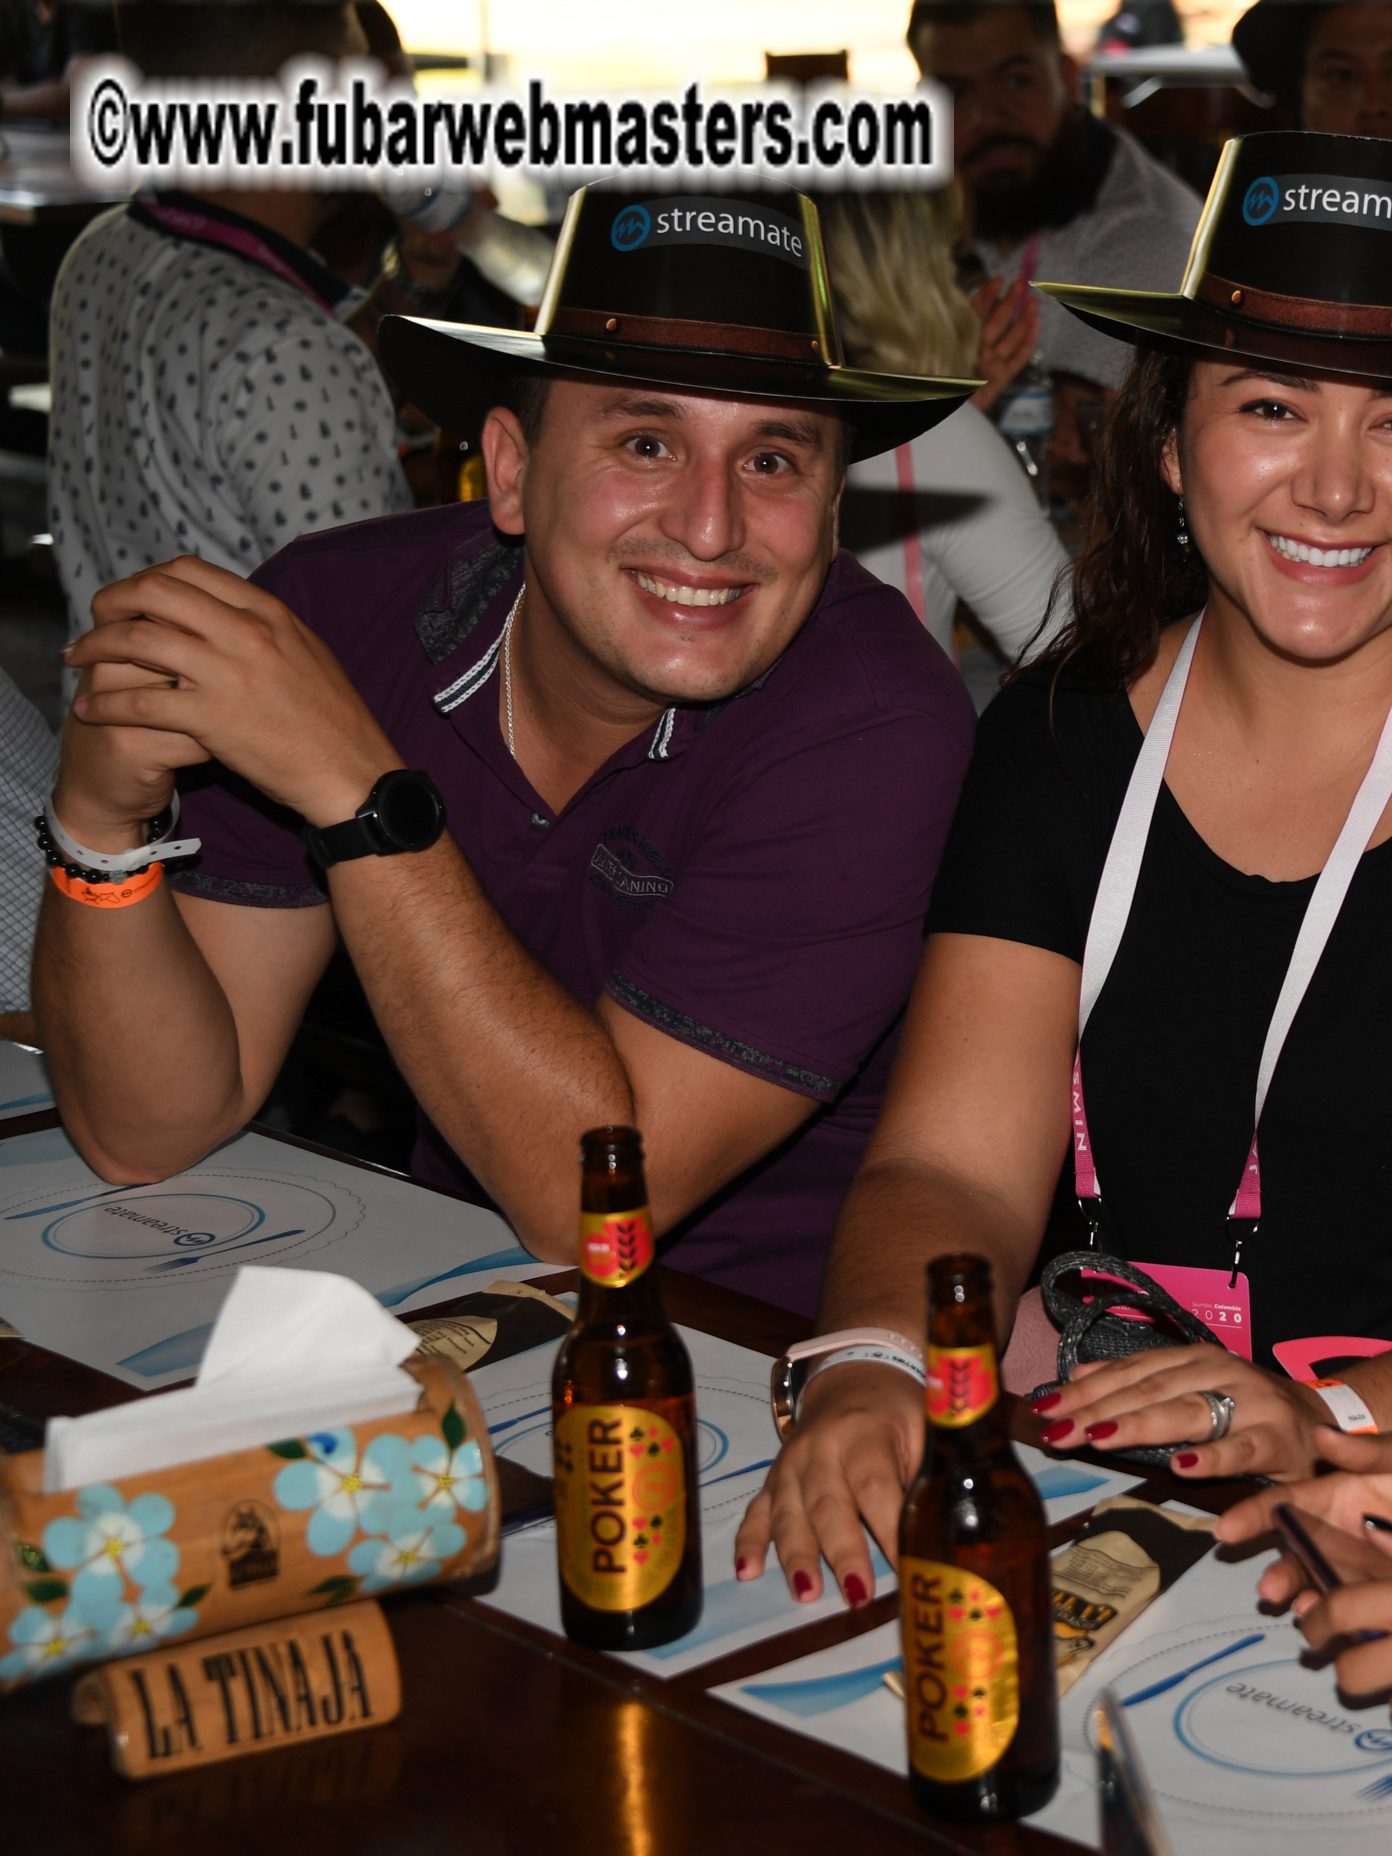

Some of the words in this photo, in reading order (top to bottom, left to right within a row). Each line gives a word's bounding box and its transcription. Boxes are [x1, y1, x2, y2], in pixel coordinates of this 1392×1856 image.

[656, 206, 805, 258] streamate
[104, 1204, 190, 1237] streamate
[588, 1417, 628, 1575] POKER
[128, 1663, 203, 1759] LA
[203, 1630, 375, 1744] TINAJA
[911, 1572, 949, 1744] POKER
[1225, 1681, 1362, 1734] streamate
